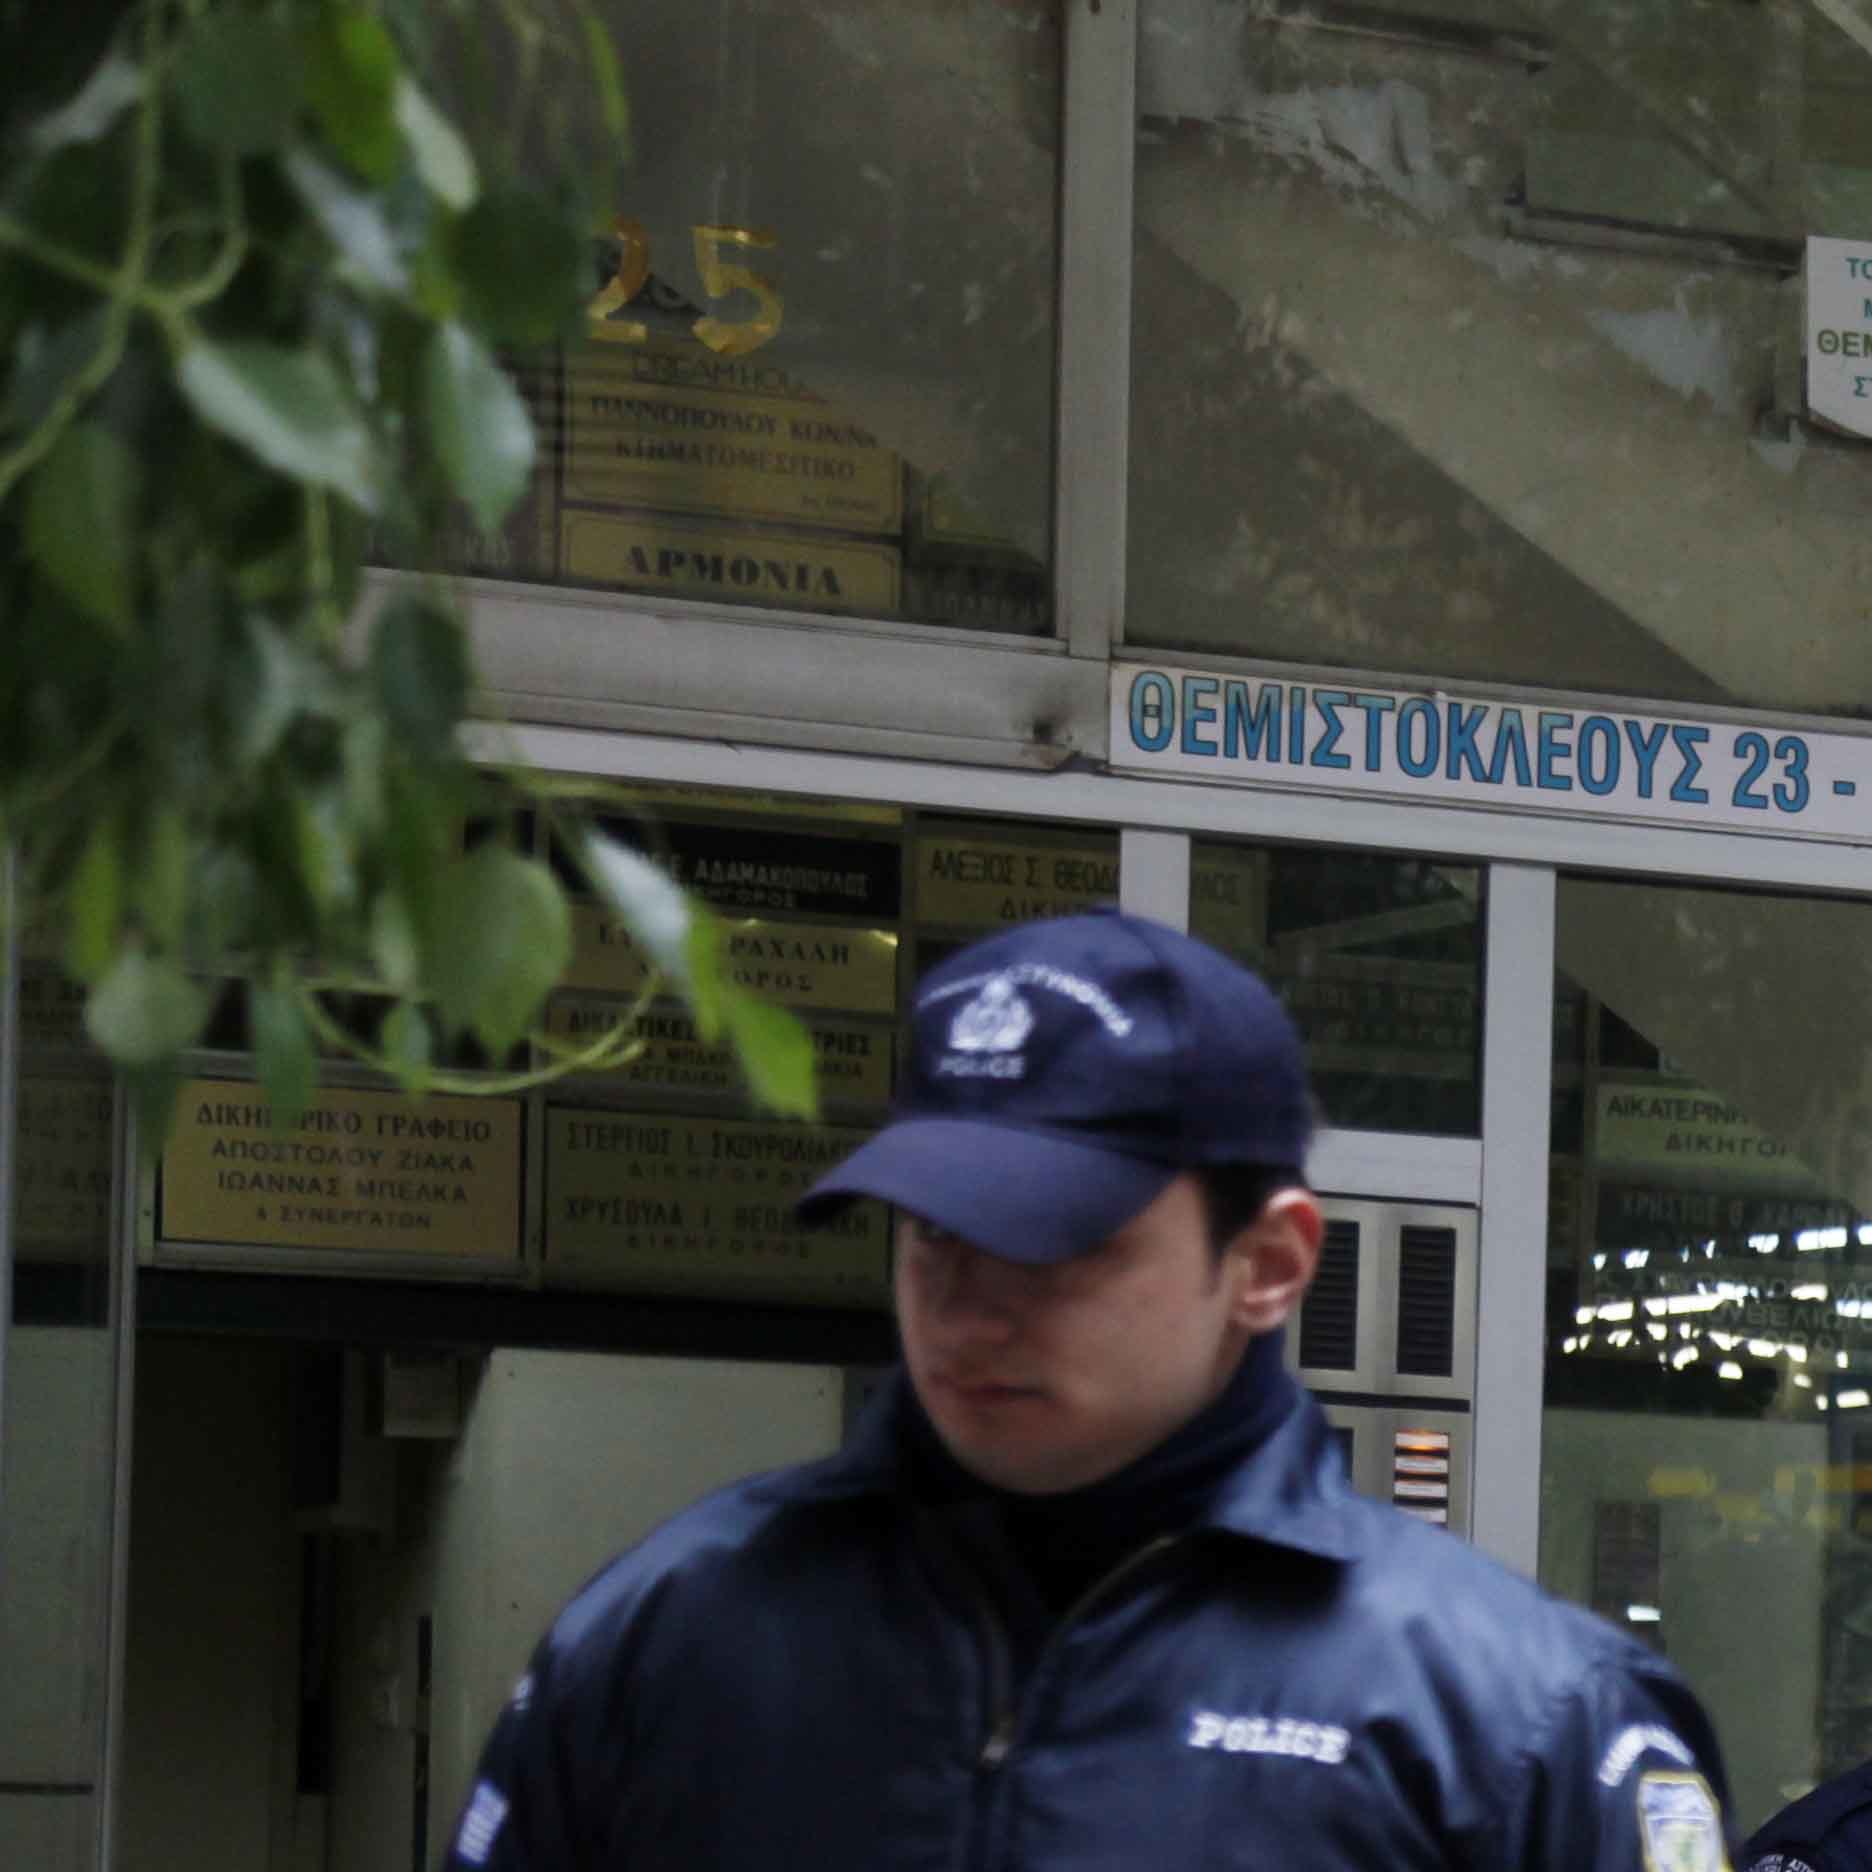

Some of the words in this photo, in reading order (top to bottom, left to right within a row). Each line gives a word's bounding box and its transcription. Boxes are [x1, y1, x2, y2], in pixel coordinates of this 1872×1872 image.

[626, 545, 842, 596] ΑΡΜΟΝΙΑ
[1127, 671, 1711, 802] ΘΕΜΙΣΤΟΚΛΕΟΥΣ
[1731, 731, 1811, 813] 23
[936, 1055, 1025, 1080] POLICE
[376, 1112, 491, 1143] ΓΡΑΦΕΙΟ
[212, 1137, 384, 1169] ΑΠΟΣΤΟΛΟΥ
[217, 1169, 340, 1198] ΙΩΑΝΝΑΣ
[1187, 1711, 1353, 1765] POLICE
